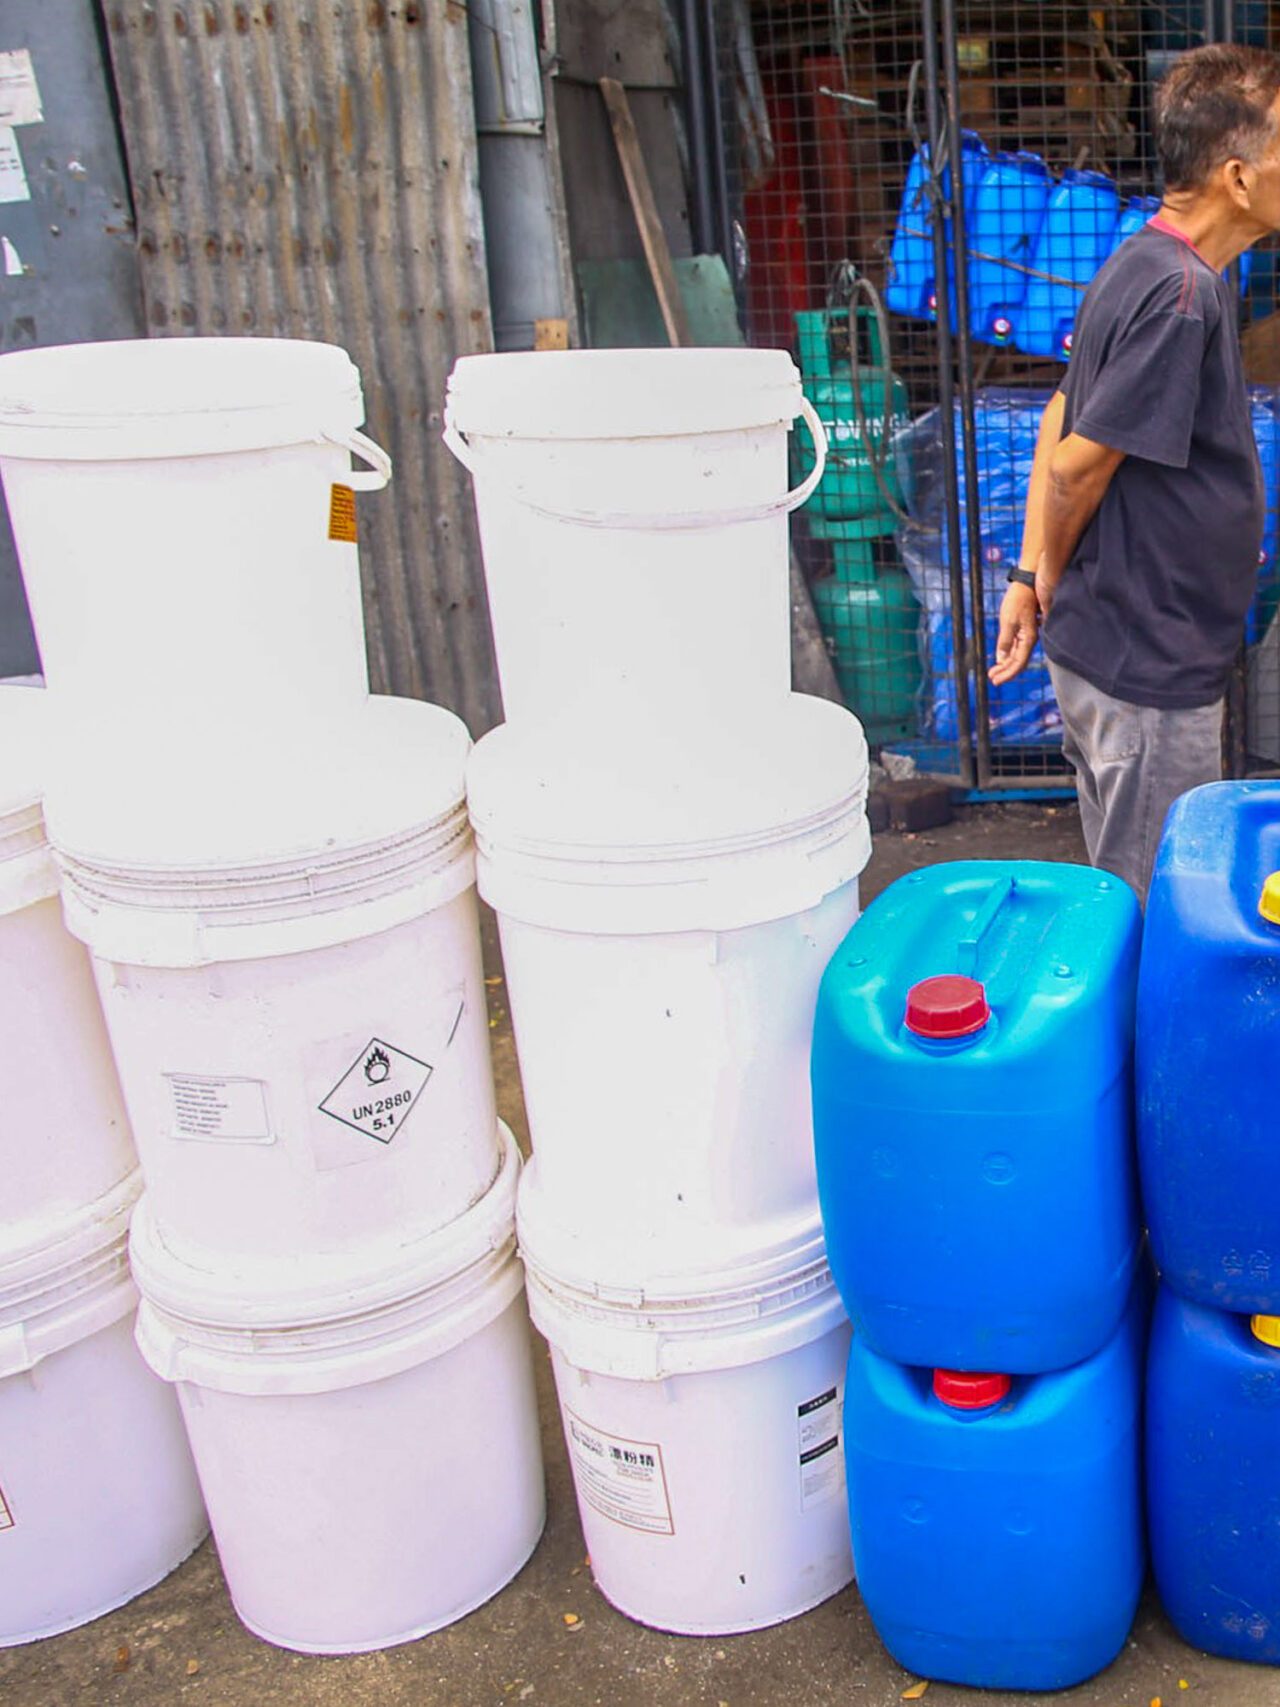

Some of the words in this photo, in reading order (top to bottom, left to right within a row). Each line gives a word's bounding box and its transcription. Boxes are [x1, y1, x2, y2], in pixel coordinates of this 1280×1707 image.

[352, 1104, 374, 1121] UN
[374, 1090, 413, 1115] 2880
[372, 1113, 396, 1131] 5.1
